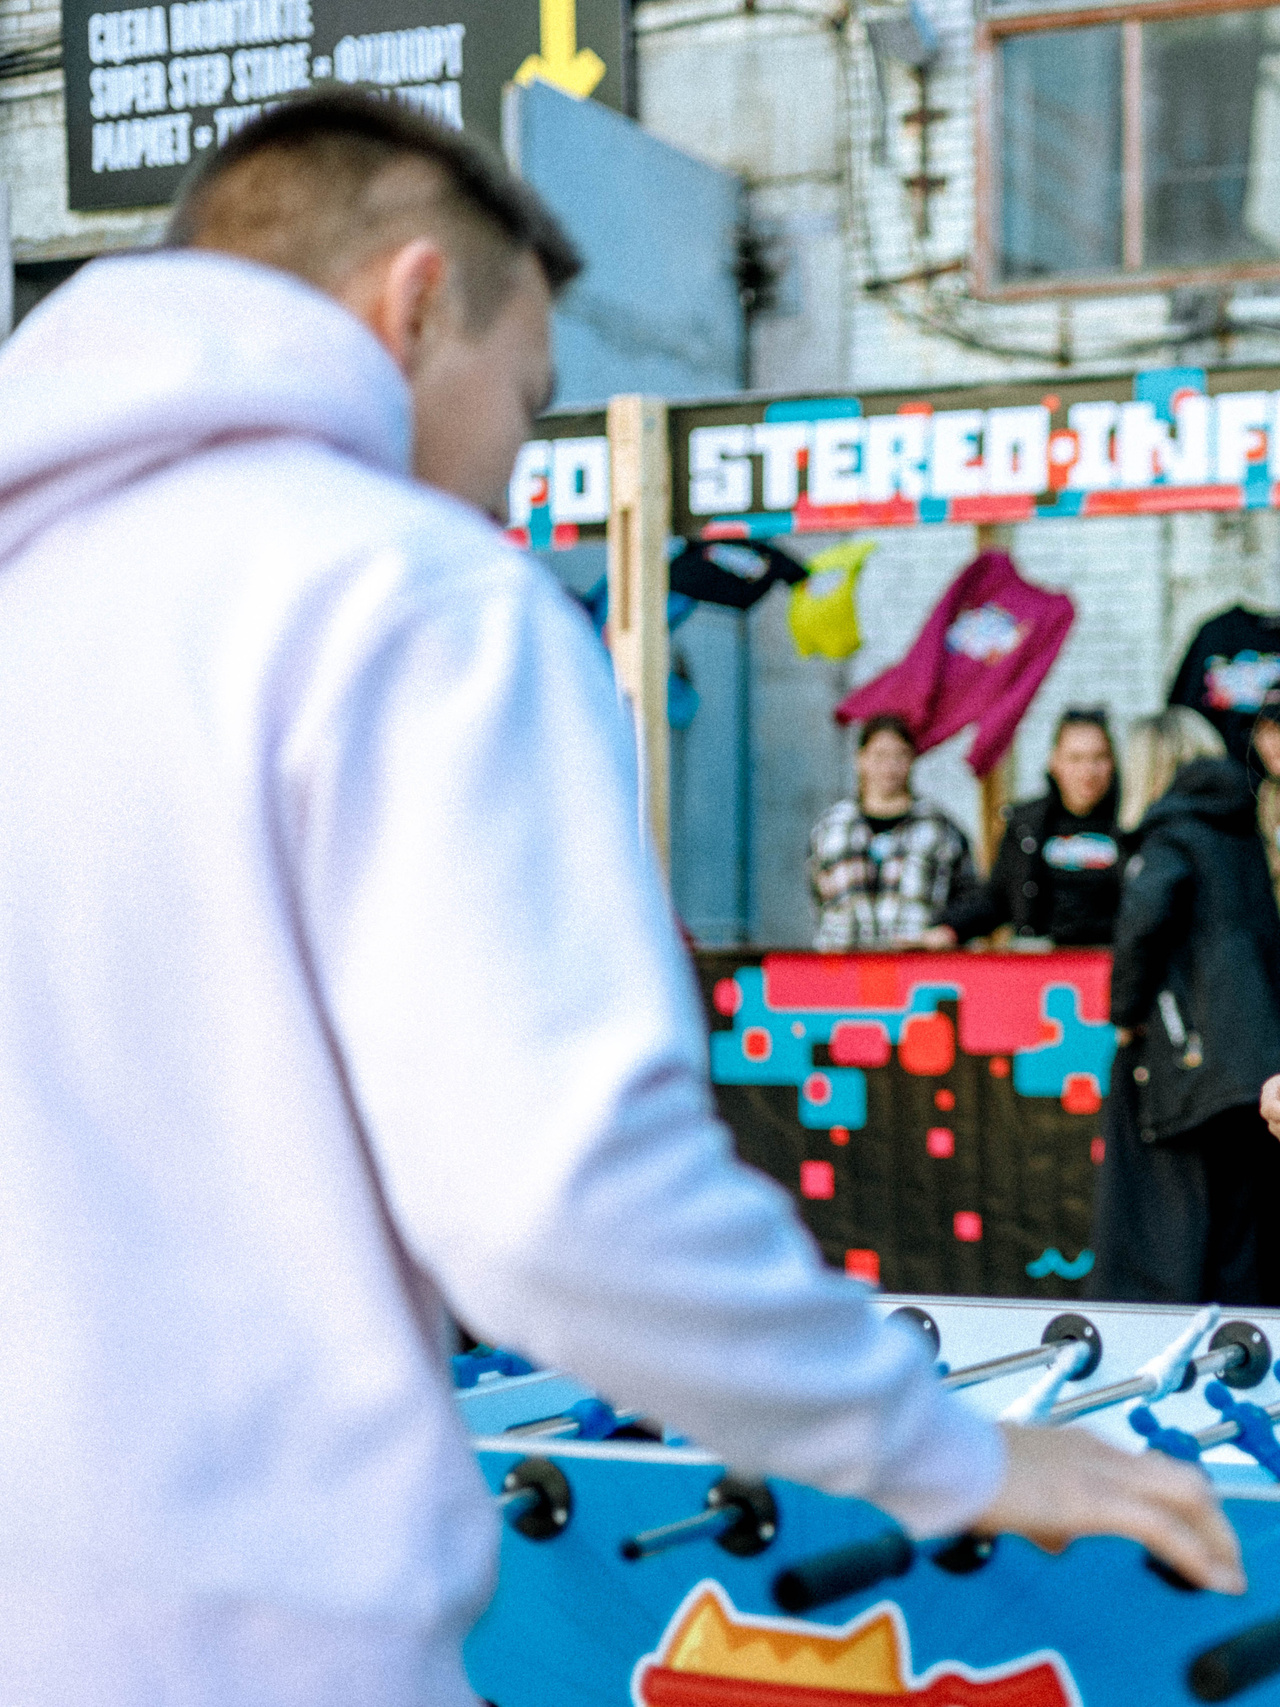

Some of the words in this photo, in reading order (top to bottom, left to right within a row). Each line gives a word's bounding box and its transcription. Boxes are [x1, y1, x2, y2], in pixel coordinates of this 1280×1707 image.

[89, 60, 168, 119] SUPER
[168, 52, 231, 110] STEP
[231, 41, 312, 102] STAGE
